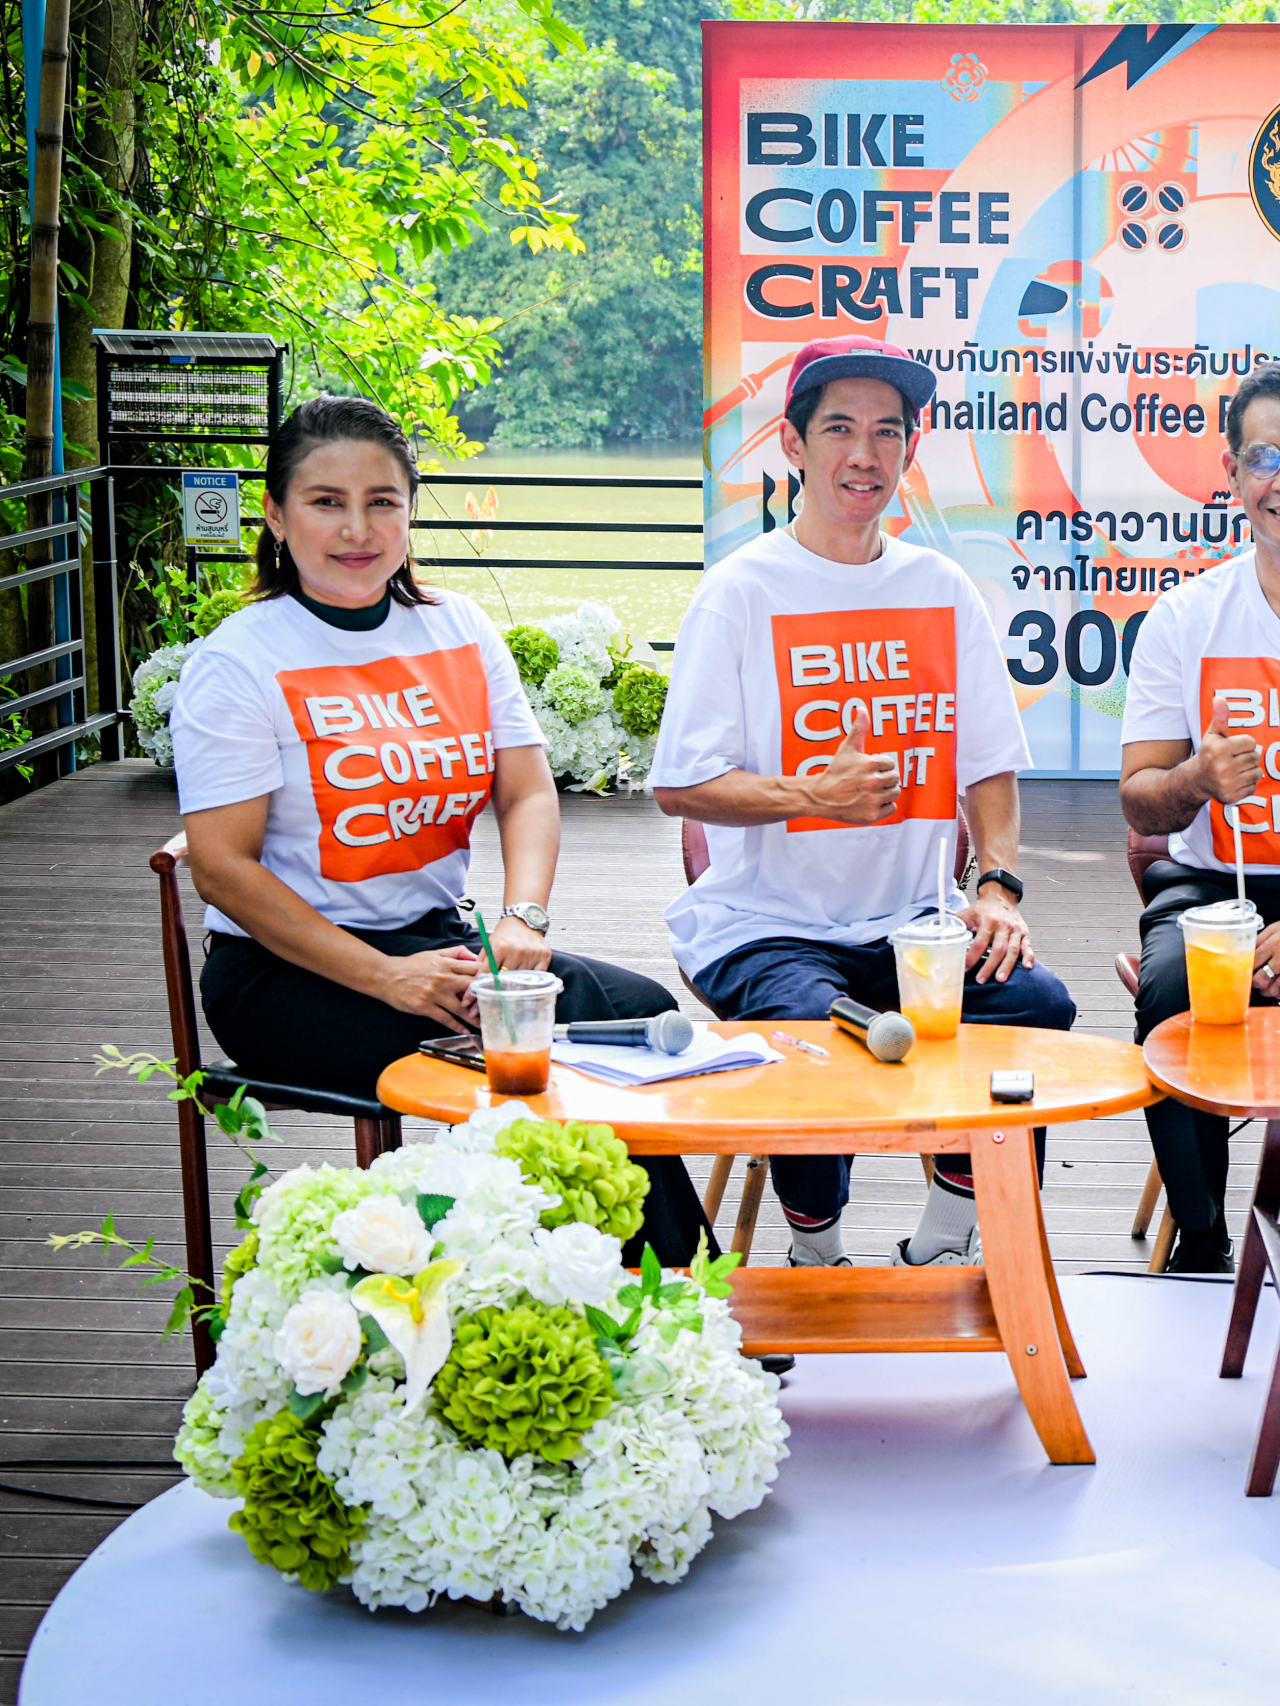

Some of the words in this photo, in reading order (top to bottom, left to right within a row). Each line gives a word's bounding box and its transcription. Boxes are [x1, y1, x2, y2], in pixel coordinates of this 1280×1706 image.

[745, 112, 925, 168] BIKE
[745, 187, 1010, 246] COFFEE
[745, 263, 979, 322] CRAFT
[917, 391, 1067, 432] hailand
[1081, 392, 1206, 434] Coffee
[193, 477, 227, 486] NOTICE
[790, 640, 910, 687] BIKE
[304, 684, 441, 738] BIKE
[793, 693, 955, 742] COFFEE
[323, 731, 496, 791] COFFEE
[332, 789, 487, 848] CRAFT
